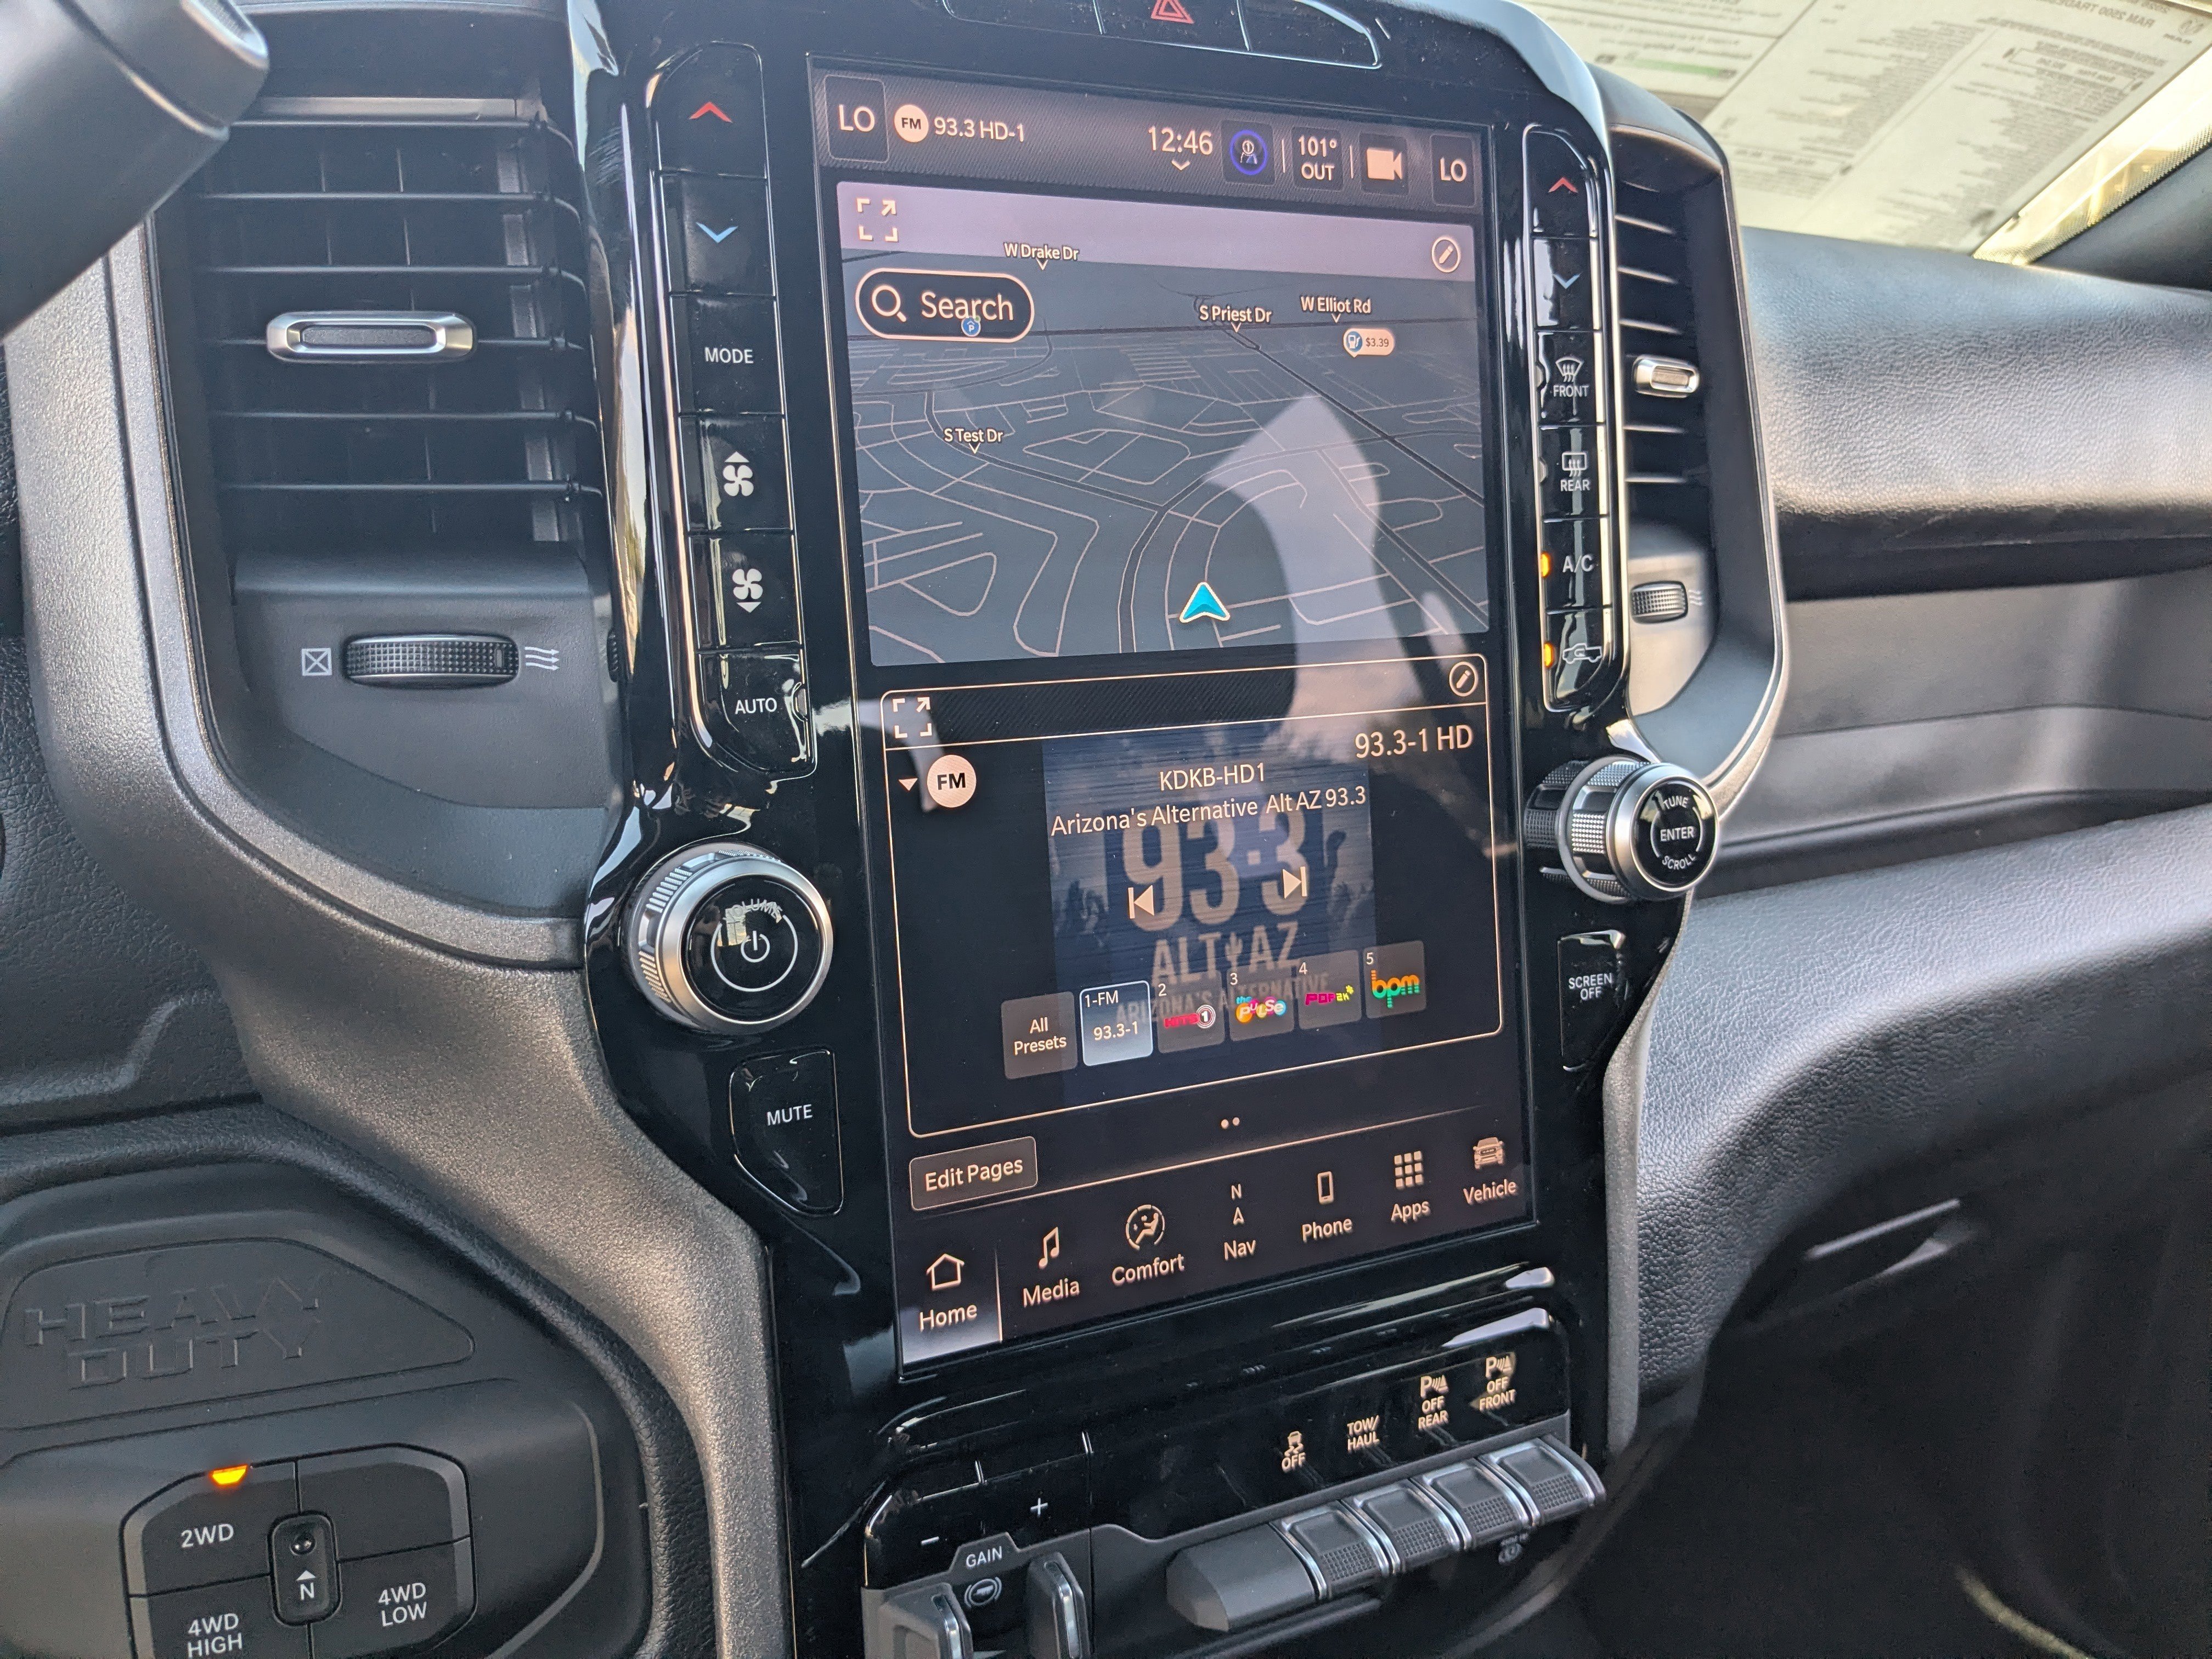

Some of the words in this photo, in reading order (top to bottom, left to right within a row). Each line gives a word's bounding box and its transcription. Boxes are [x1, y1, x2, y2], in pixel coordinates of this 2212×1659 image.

[838, 104, 876, 133] LO
[901, 116, 922, 131] FM
[934, 116, 975, 138] 93.3
[979, 120, 1025, 143] HD-1
[1148, 125, 1214, 155] 12:46
[1298, 135, 1338, 158] 101°
[1301, 163, 1335, 181] OUT
[1440, 157, 1468, 183] LO
[1003, 242, 1019, 257] W
[1020, 244, 1060, 260] Drake
[1062, 246, 1079, 261] Dr
[921, 290, 1014, 321] Search
[1199, 305, 1209, 320] S
[1210, 306, 1252, 323] Priest
[1254, 308, 1272, 323] Dr
[1300, 296, 1316, 311] W
[1317, 297, 1351, 313] Elliot
[1353, 298, 1372, 314] Rd
[1365, 336, 1390, 349] $3.39
[704, 346, 754, 364] MODE
[1553, 385, 1589, 398] FRONT
[944, 428, 954, 443] S
[955, 428, 985, 443] Test
[986, 428, 1005, 443] Dr
[1560, 478, 1590, 492] REAR
[1562, 554, 1594, 573] A/C
[735, 697, 778, 715] AUTO
[1355, 728, 1429, 759] 93.3-1
[1436, 724, 1474, 751] HD
[936, 772, 967, 791] FM
[1159, 762, 1265, 791] KDKB-HD1
[1051, 807, 1147, 836] Arizona's
[1150, 798, 1258, 826] Alternative
[1266, 792, 1293, 814] Alt
[1295, 789, 1322, 810] AZ
[1325, 785, 1367, 808] 93.3
[1663, 795, 1689, 810] TUNE
[1660, 826, 1695, 842] ENTER
[1662, 853, 1696, 871] SCROLL
[722, 898, 783, 920] VOLUME
[1152, 931, 1222, 987] ALT
[1249, 921, 1302, 974] AZ
[1365, 952, 1374, 966] 5
[1229, 973, 1238, 985] 3
[1298, 962, 1308, 975] 4
[1158, 984, 1167, 997] 2
[1371, 969, 1420, 1008] bpm
[1568, 972, 1613, 989] SCREEN
[1085, 990, 1119, 1008] 1-FM
[1580, 985, 1602, 1001] OFF
[1029, 1017, 1049, 1034] All
[1093, 1021, 1139, 1041] 93.3-1
[1013, 1034, 1067, 1056] Presets
[767, 1104, 813, 1126] MUTE
[925, 1166, 964, 1192] Edit
[967, 1158, 1024, 1187] Pages
[1231, 1184, 1242, 1201] N
[1463, 1178, 1517, 1205] Vehicle
[1390, 1200, 1431, 1224] Apps
[1301, 1217, 1353, 1244] Phone
[1223, 1239, 1257, 1262] Nav
[1111, 1252, 1185, 1287] Comfort
[1023, 1278, 1080, 1308] Media
[919, 1304, 978, 1333] Home
[1486, 1376, 1509, 1394] OFF
[1421, 1396, 1445, 1414] OFF
[1479, 1389, 1516, 1412] FRONT
[1347, 1415, 1380, 1436] TOW/
[1418, 1410, 1449, 1430] REAR
[1347, 1431, 1380, 1454] HAUL
[1281, 1452, 1306, 1474] OFF
[180, 1523, 234, 1549] 2WD
[965, 1545, 1003, 1568] GAIN
[300, 1583, 315, 1600] N
[378, 1582, 426, 1606] 4WD
[187, 1612, 239, 1638] 4WD
[381, 1601, 427, 1628] LOW
[187, 1633, 244, 1658] HIGH
